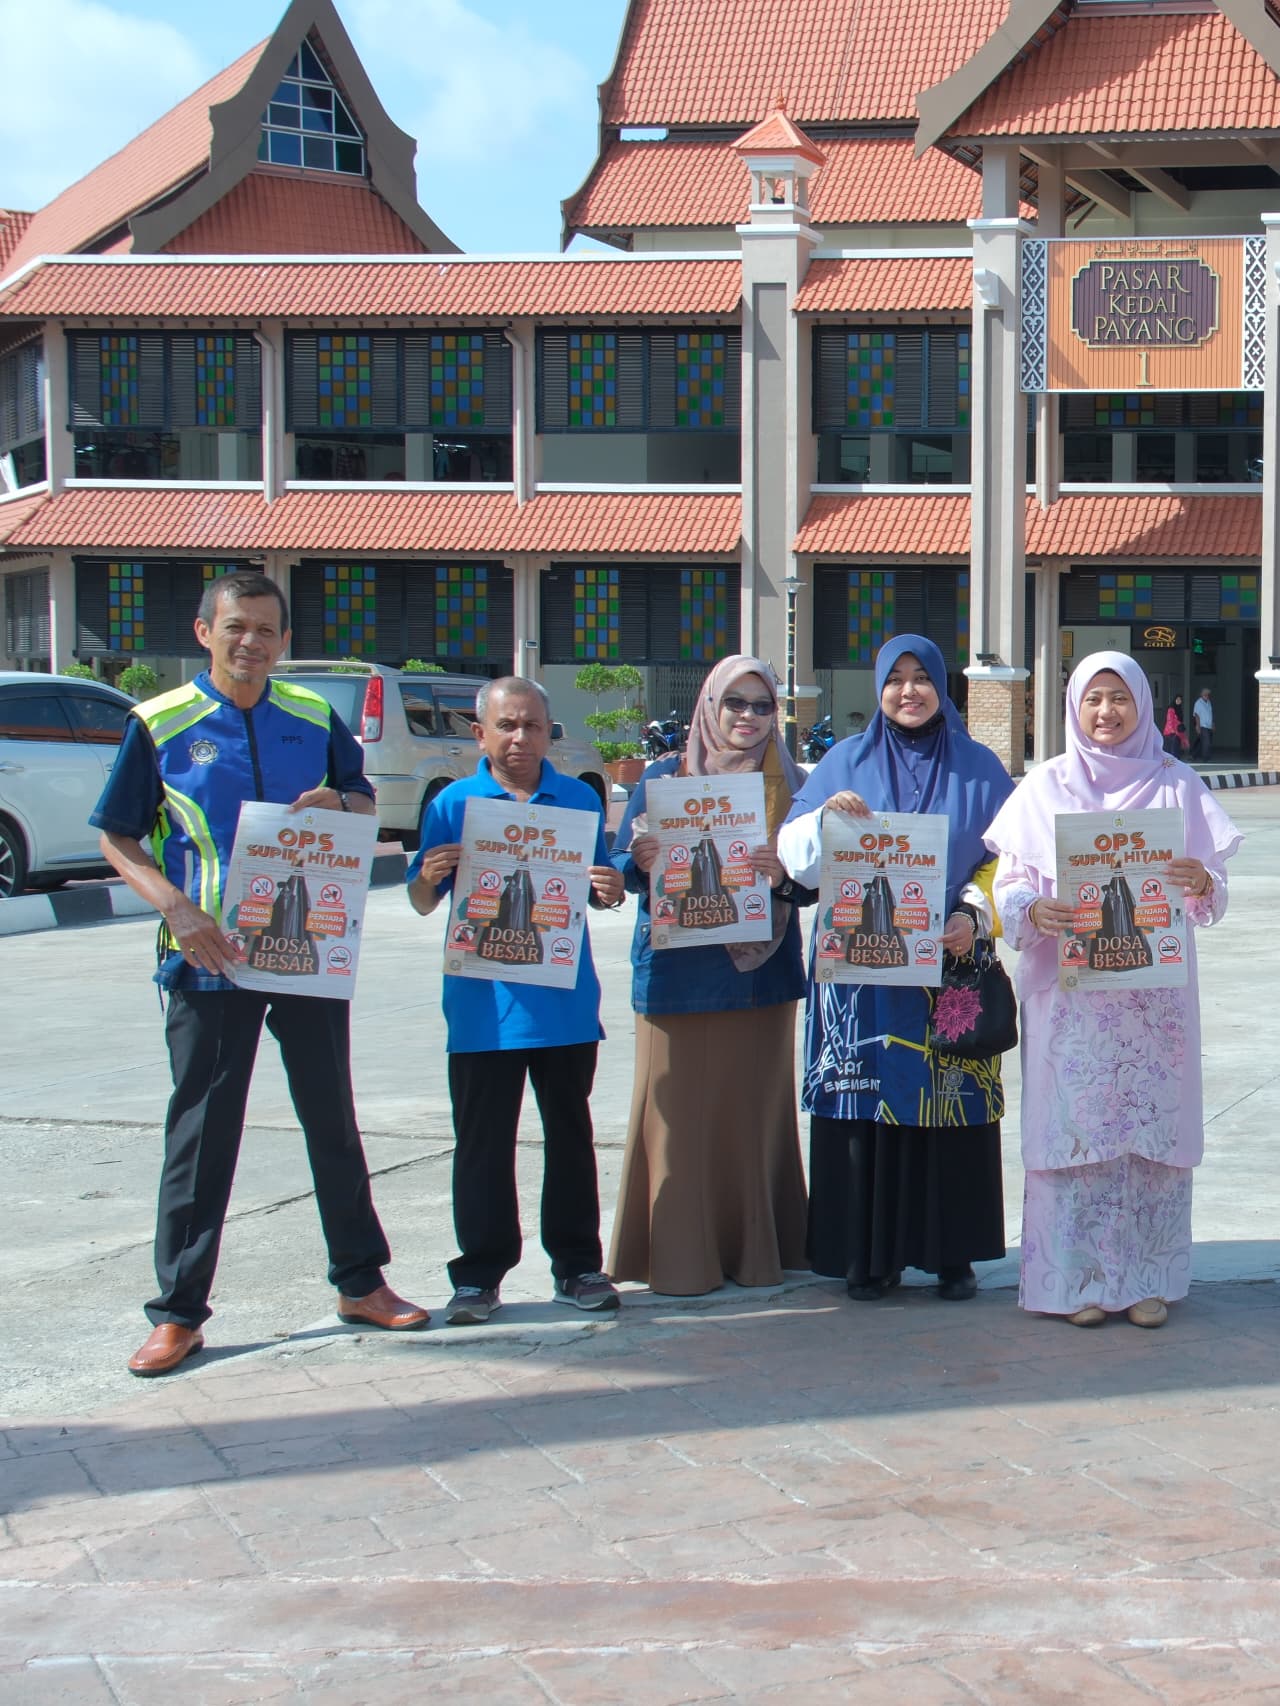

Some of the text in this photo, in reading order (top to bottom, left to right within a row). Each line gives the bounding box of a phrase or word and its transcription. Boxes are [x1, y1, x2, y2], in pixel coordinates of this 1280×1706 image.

[1100, 266, 1190, 293] PASAR
[1108, 294, 1178, 317] KEDAI
[1094, 316, 1197, 342] PAYANG
[1136, 351, 1153, 387] 1
[281, 735, 303, 745] PPS
[684, 795, 732, 815] OPS
[660, 812, 756, 830] SUPIK HITAM
[278, 828, 335, 852] OPS
[504, 825, 557, 847] OPS
[860, 834, 910, 852] OPS
[1095, 831, 1146, 852] OPS
[246, 844, 361, 869] SUPIK HITAM
[475, 840, 583, 863] SUPIK HITAM
[833, 851, 936, 868] SUPIK HITAM
[1069, 849, 1172, 867] SUPIK HITAM
[688, 894, 729, 909] DOSA
[684, 909, 734, 925] BESAR
[1079, 912, 1100, 920] ENDA
[1135, 908, 1167, 916] PENJARA
[1142, 916, 1166, 924] TAHUN
[1074, 920, 1101, 929] RM3000
[262, 936, 311, 955] DOSA
[490, 927, 536, 946] DOSA
[857, 934, 900, 948] DOSA
[1098, 935, 1143, 951] DOSA
[483, 943, 539, 962] BESAR
[852, 949, 904, 965] BESAR
[1095, 951, 1149, 968] BESAR
[255, 952, 315, 973] BESAR
